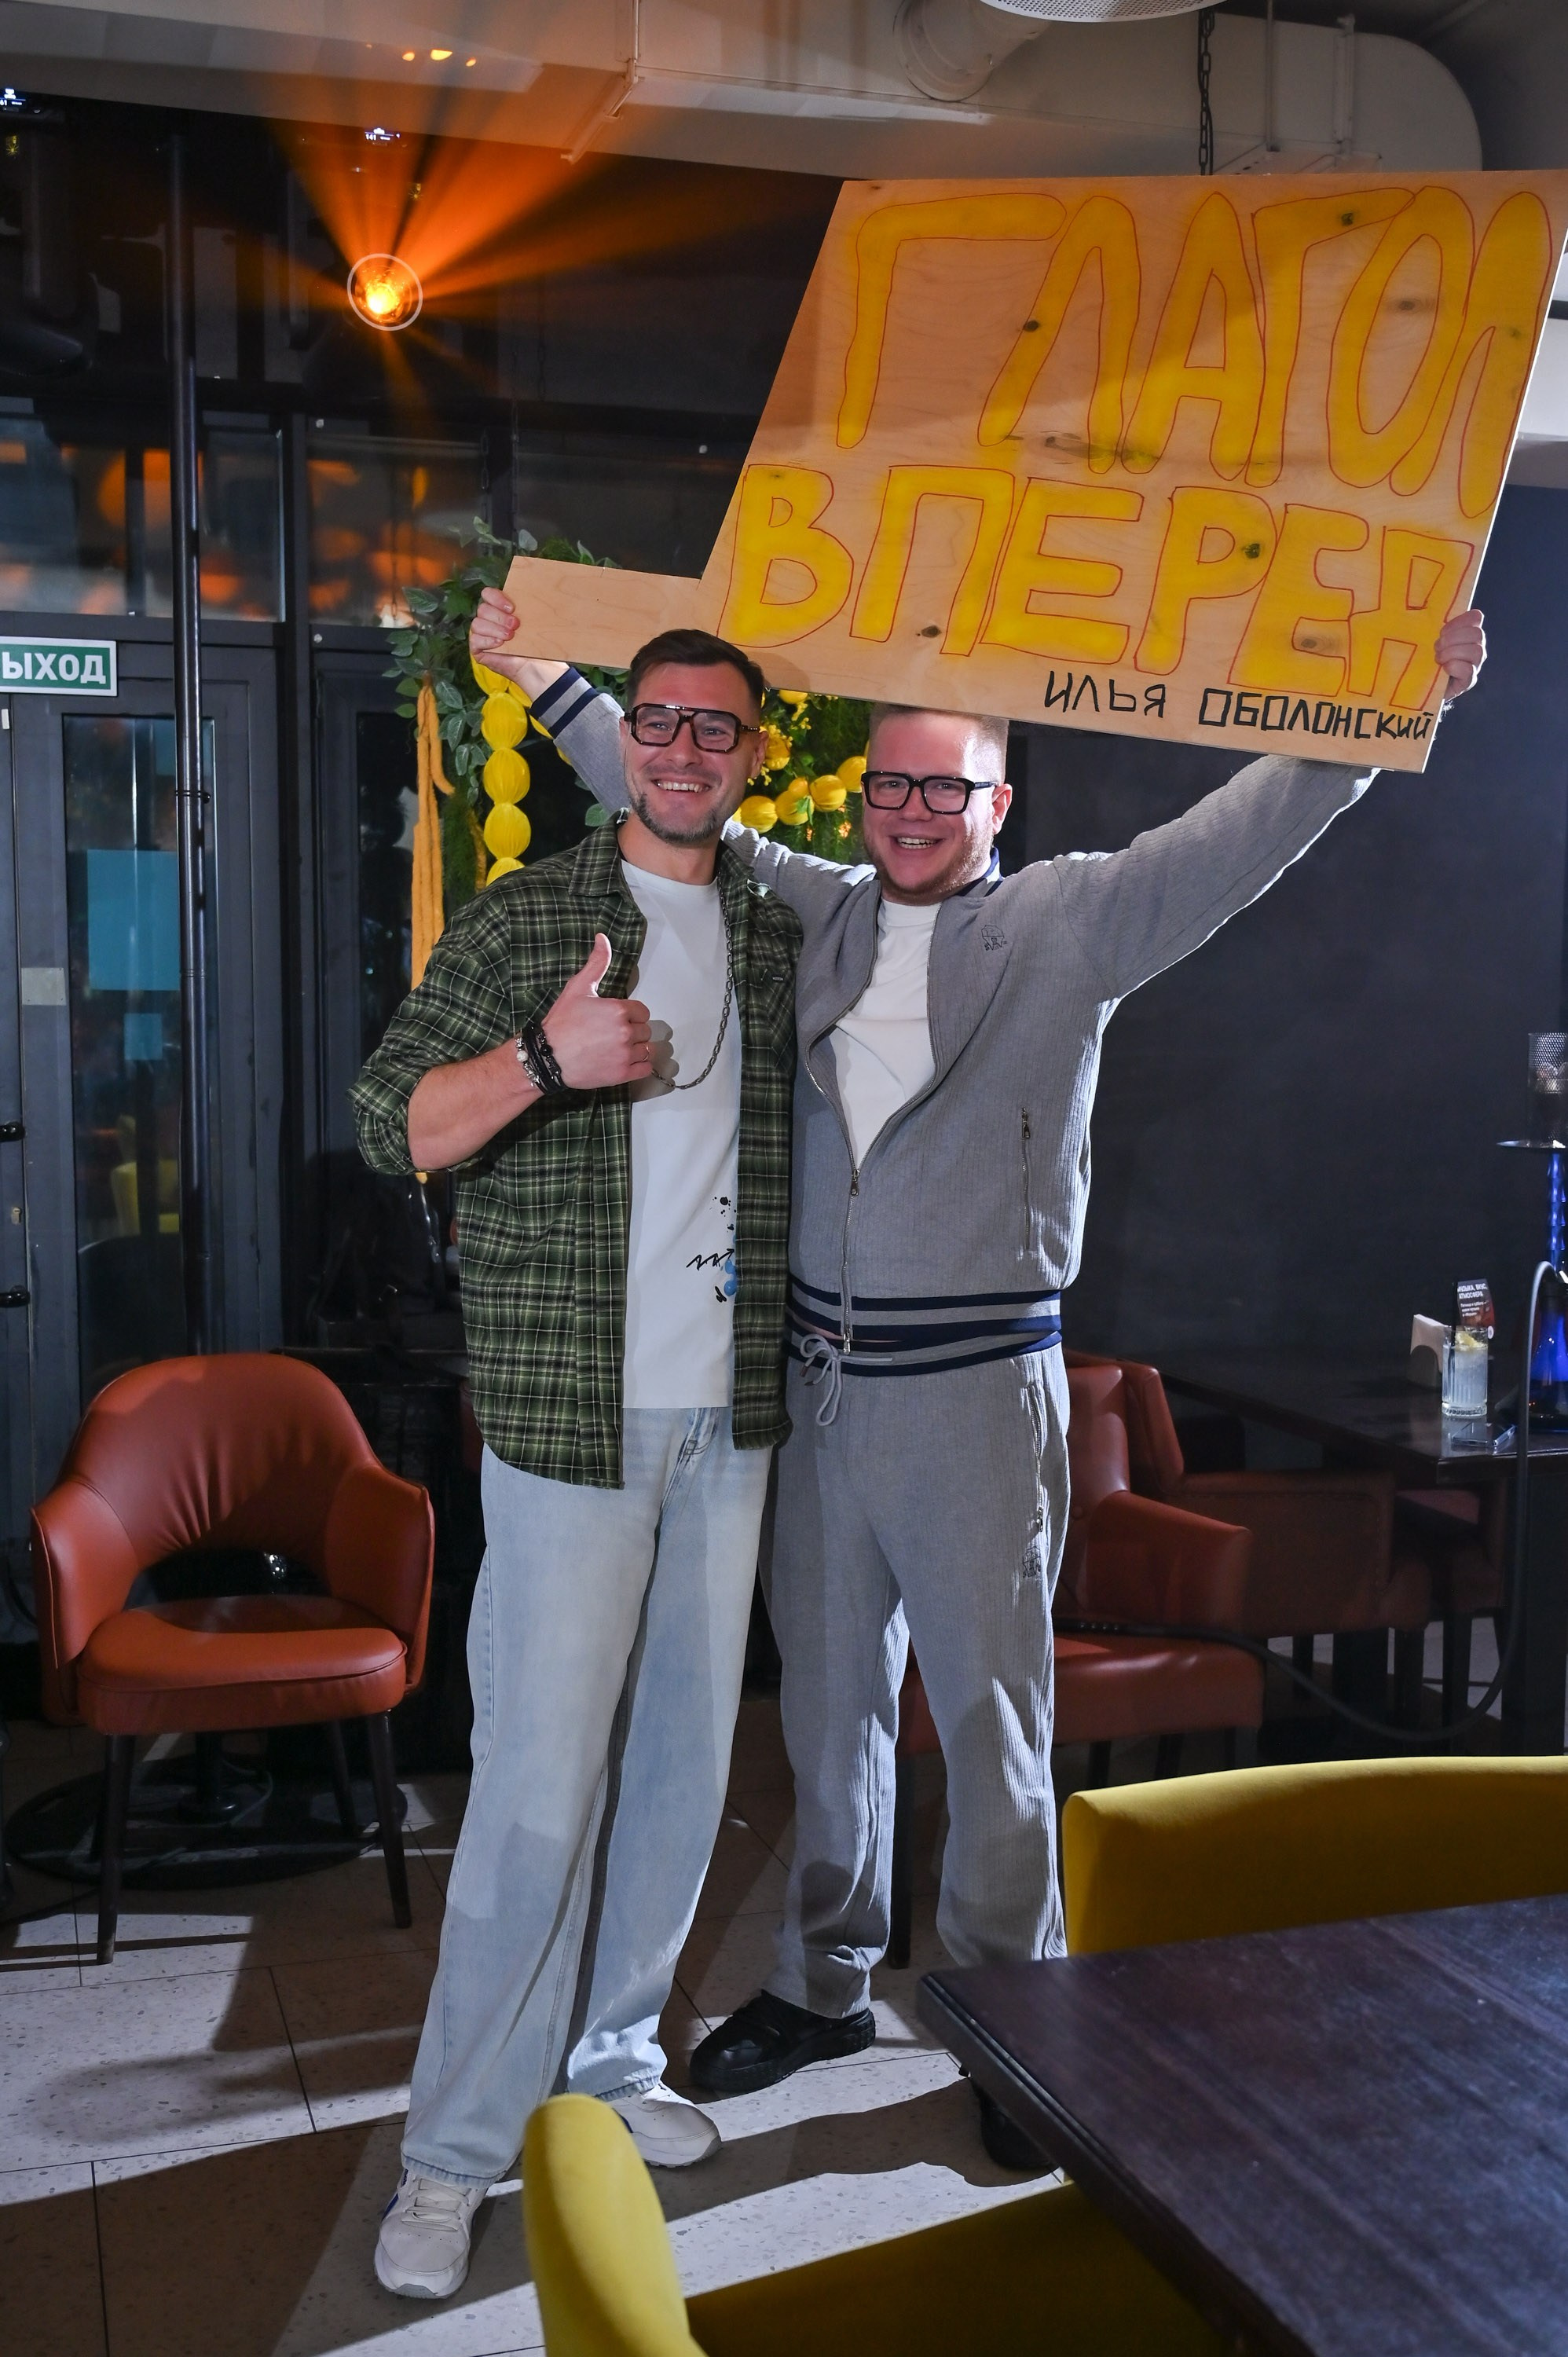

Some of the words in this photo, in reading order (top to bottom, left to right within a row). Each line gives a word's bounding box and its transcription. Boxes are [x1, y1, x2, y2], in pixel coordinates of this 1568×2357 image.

[837, 185, 1552, 519] ГЛАГОЛ
[2, 651, 107, 685] ЫХОД
[1043, 669, 1167, 719] ИЛЬЯ
[1198, 687, 1434, 741] ОБОЛОНСКИЙ
